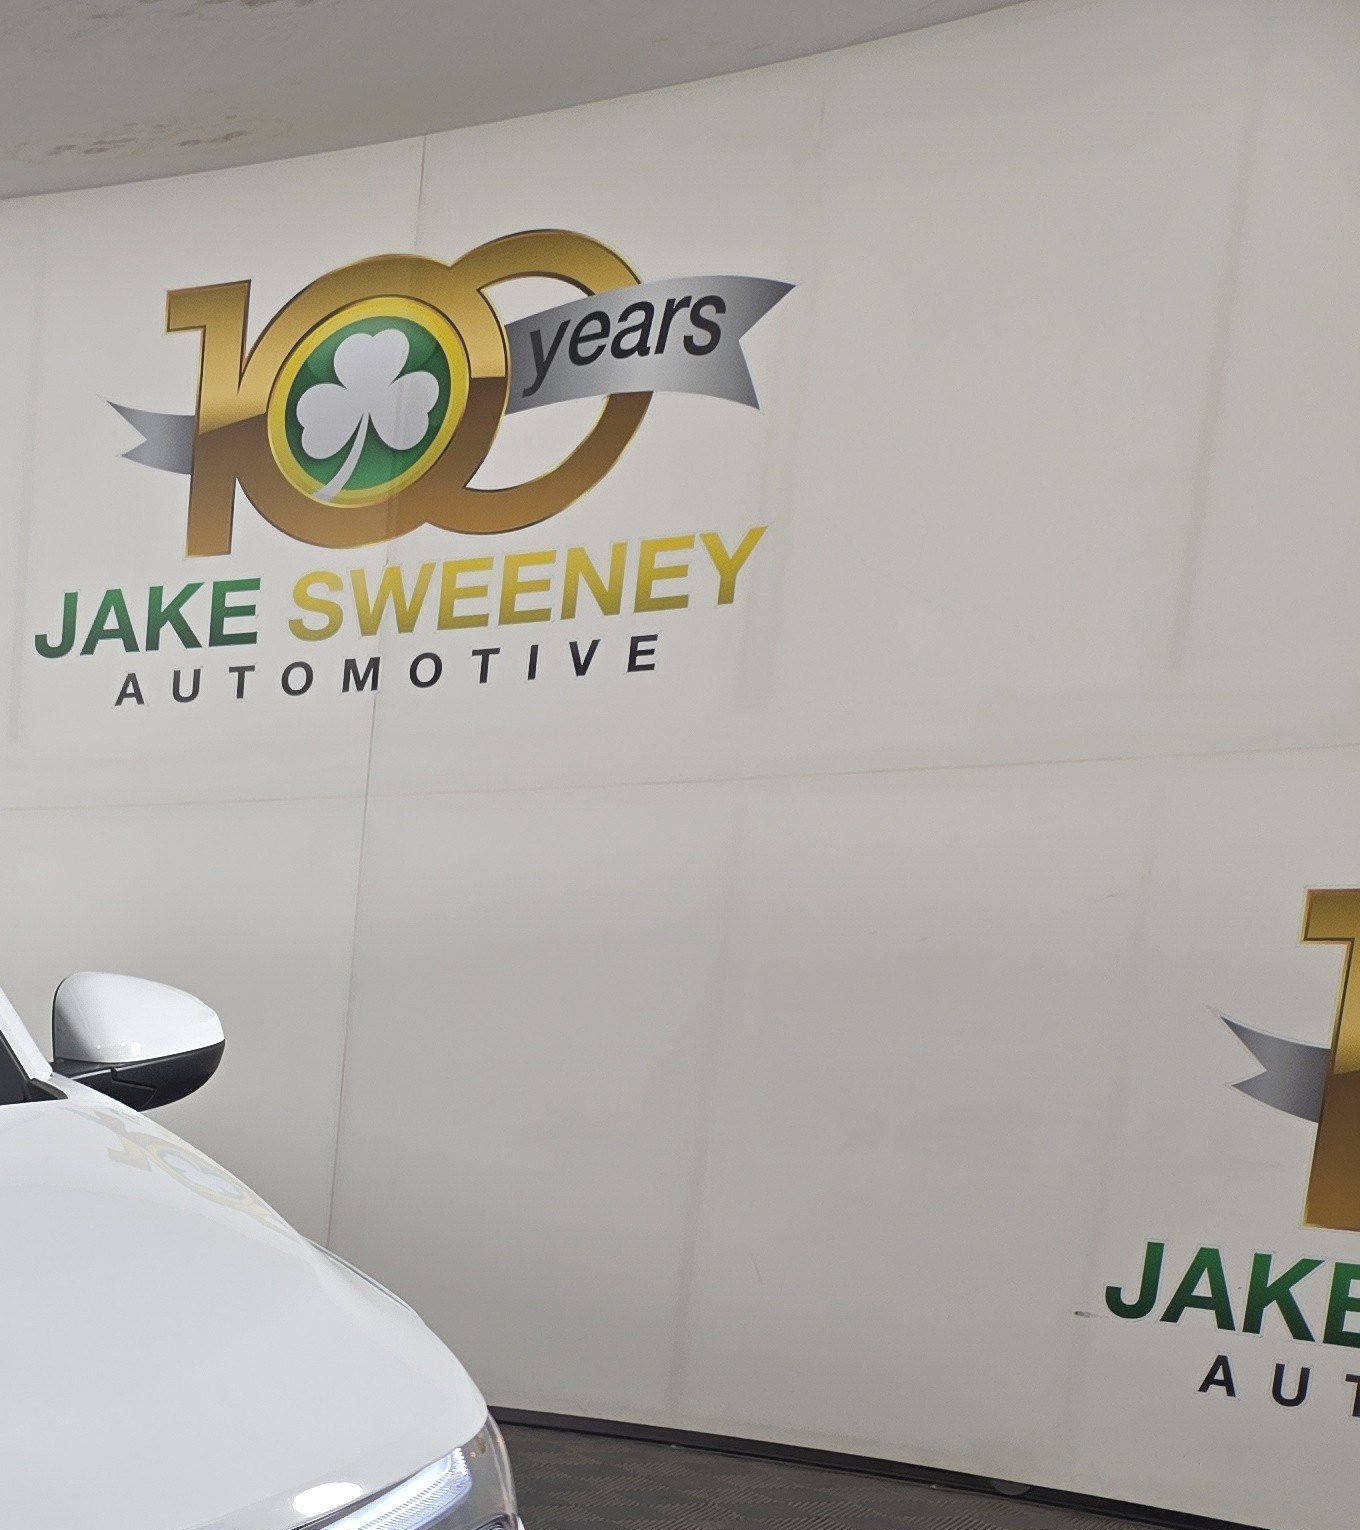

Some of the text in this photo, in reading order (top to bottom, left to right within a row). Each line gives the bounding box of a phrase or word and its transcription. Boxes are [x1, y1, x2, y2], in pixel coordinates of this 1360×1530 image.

[164, 228, 726, 557] 100 years
[34, 525, 768, 659] JAKE SWEENEY
[114, 634, 659, 708] AUTOMOTIVE
